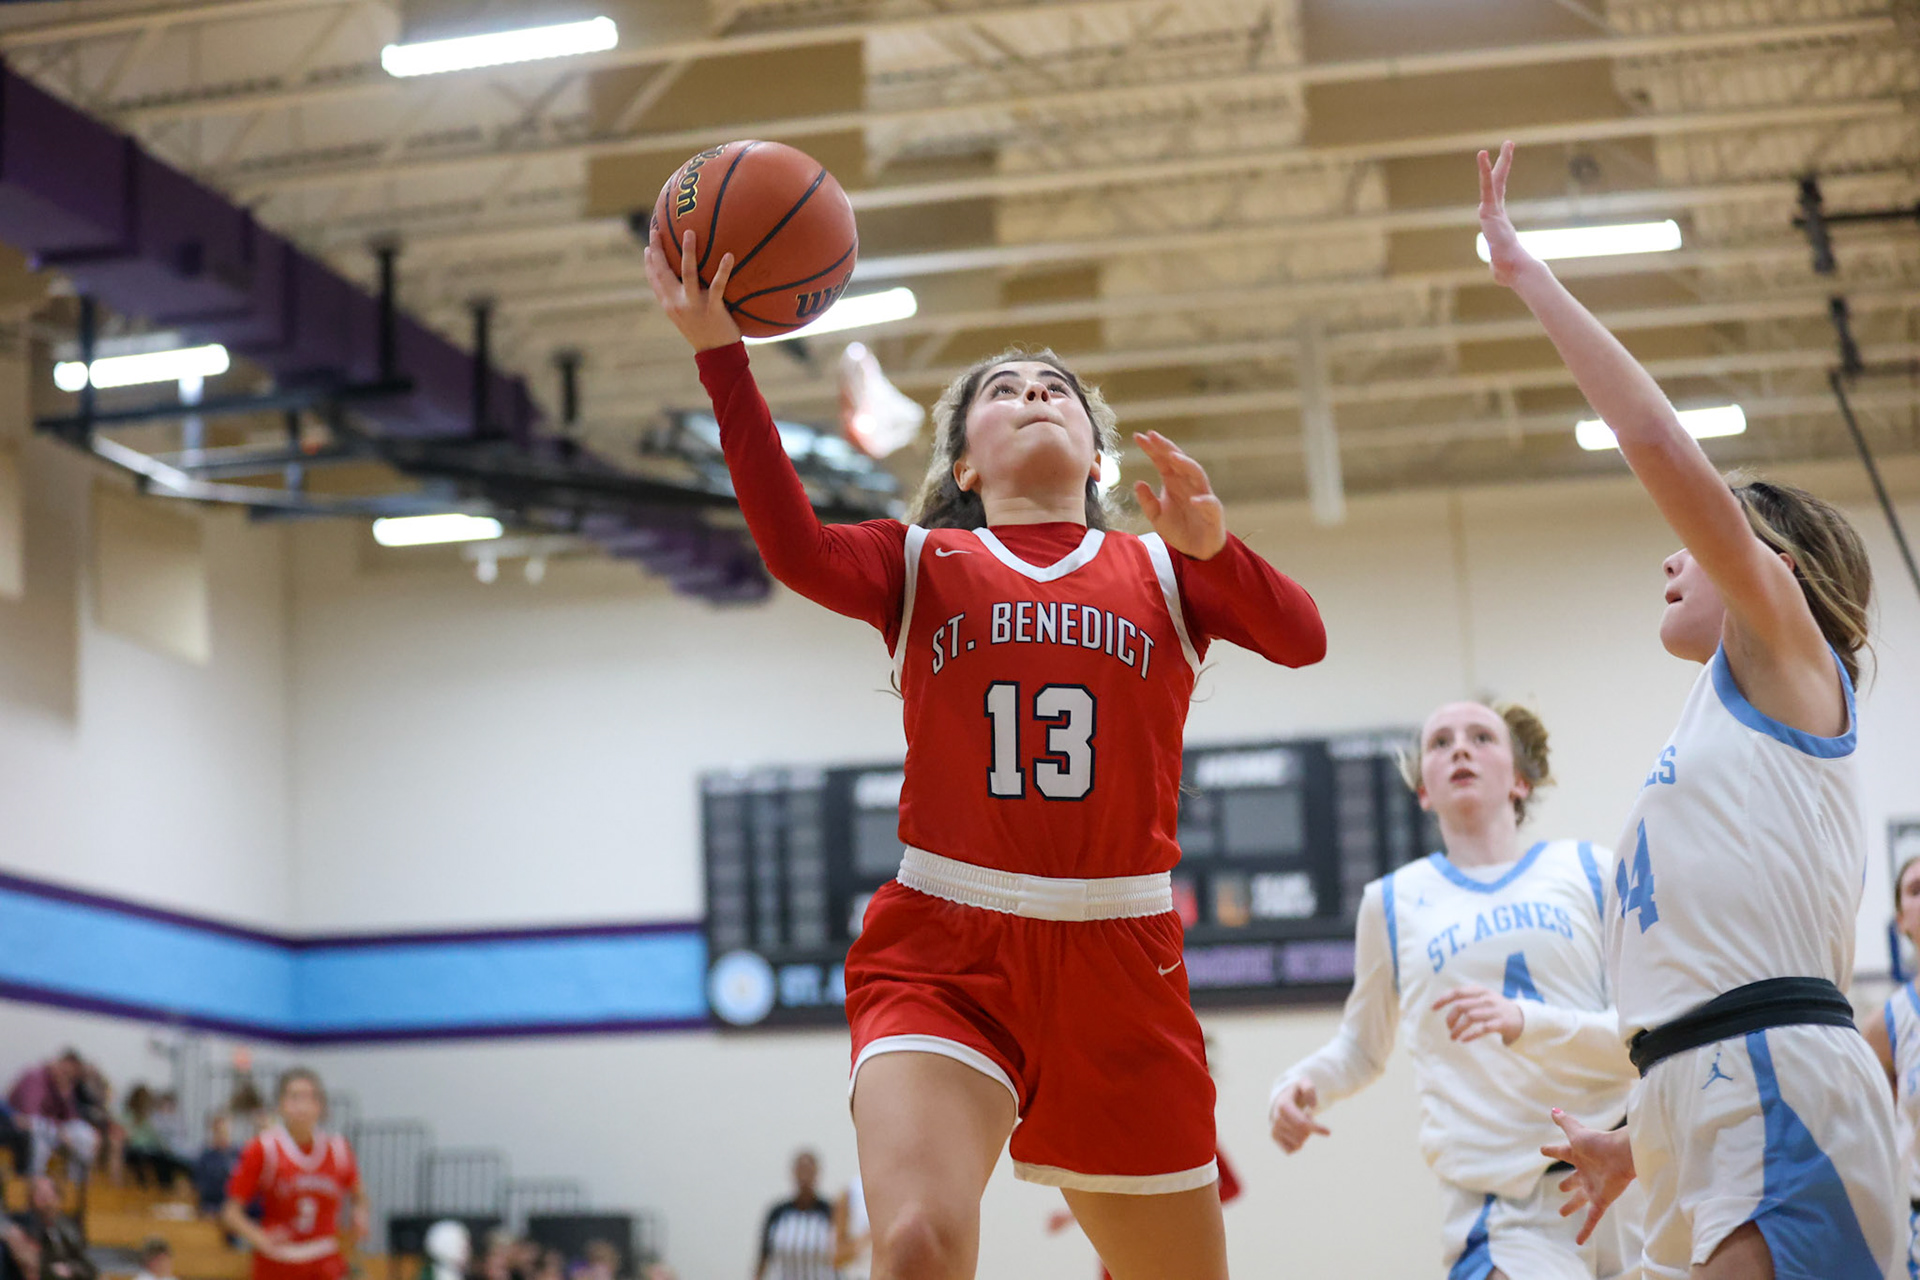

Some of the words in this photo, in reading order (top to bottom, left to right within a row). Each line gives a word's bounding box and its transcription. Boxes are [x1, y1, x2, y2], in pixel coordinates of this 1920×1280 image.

[931, 612, 976, 676] ST.
[991, 601, 1155, 681] BENEDICT
[984, 680, 1097, 800] 13
[1427, 924, 1467, 974] ST.
[1474, 901, 1573, 940] AGNES
